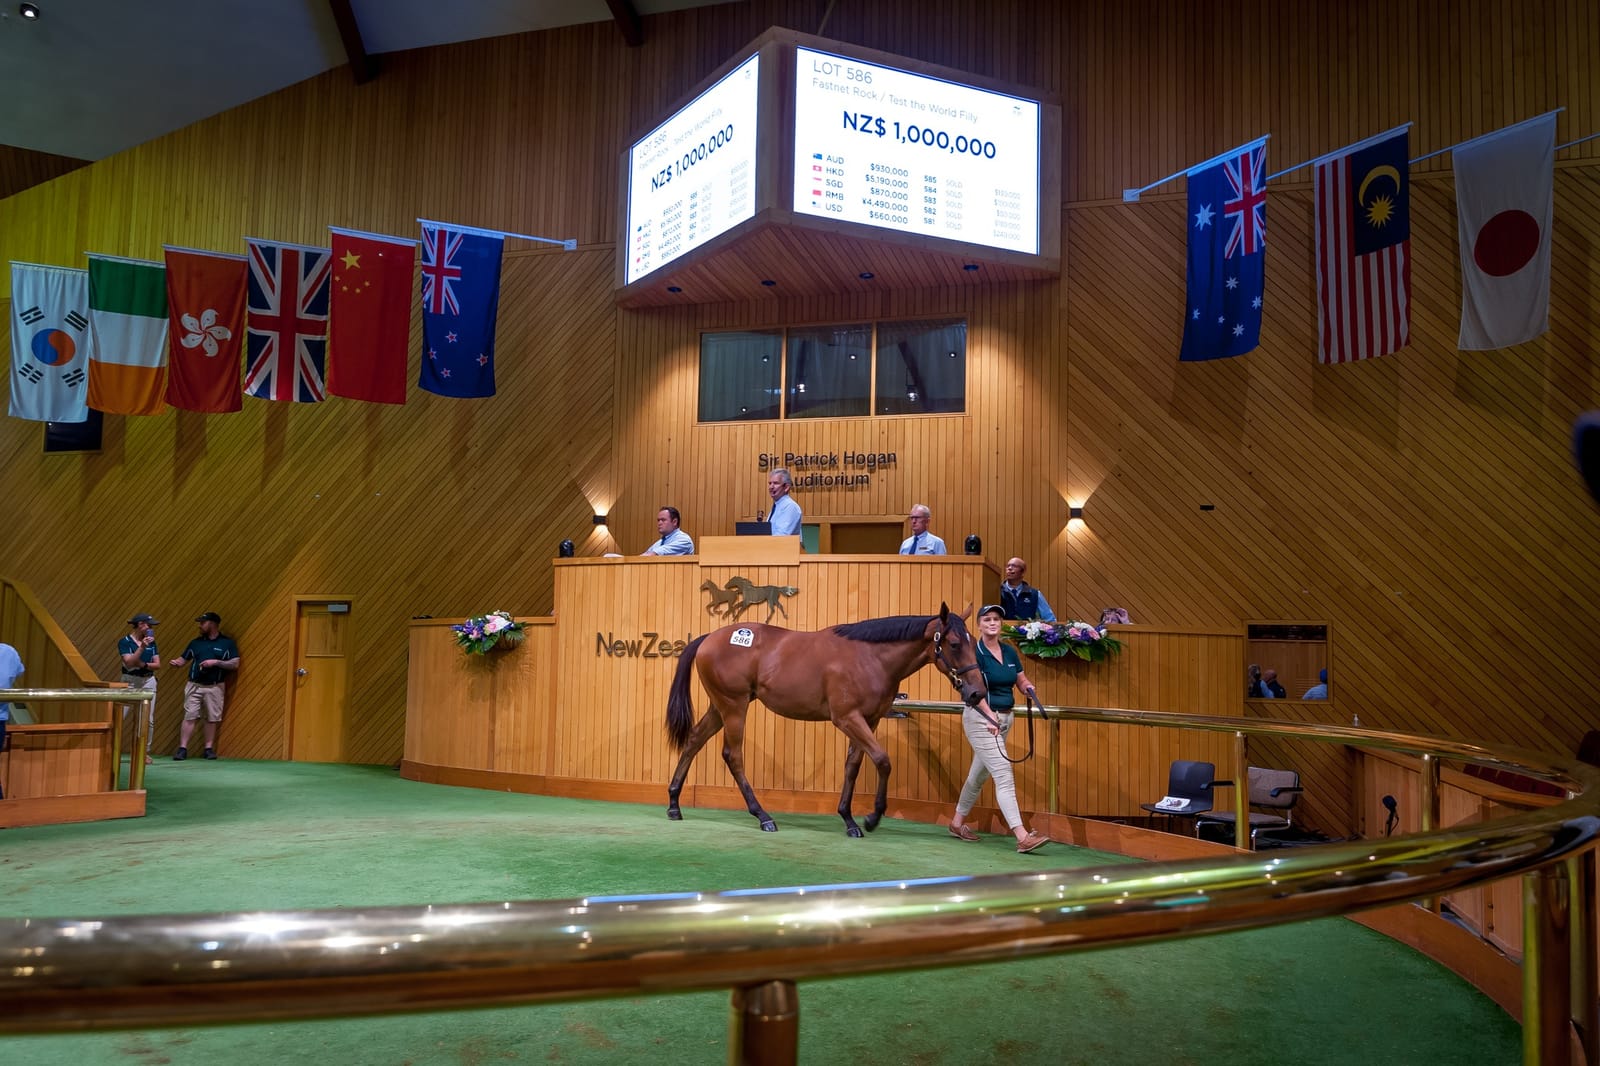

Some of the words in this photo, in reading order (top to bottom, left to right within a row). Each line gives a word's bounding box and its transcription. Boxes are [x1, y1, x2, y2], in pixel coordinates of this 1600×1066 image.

[813, 60, 842, 78] LOT
[846, 68, 872, 84] 586
[812, 78, 850, 94] Fastnet
[853, 86, 878, 100] Rock
[889, 94, 908, 108] Test
[911, 99, 926, 111] the
[929, 103, 957, 118] World
[959, 110, 978, 124] Filly
[843, 110, 886, 138] NZ$
[894, 122, 996, 159] 1,000,000
[651, 164, 672, 192] NZ$
[676, 124, 734, 177] 1,000,000
[826, 154, 844, 164] AUD
[826, 167, 844, 176] HKD
[826, 178, 843, 188] SGD
[826, 190, 844, 200] RMB
[826, 203, 843, 212] USD
[758, 453, 779, 468] Sir
[784, 452, 838, 467] Patrick
[843, 451, 897, 468] Hogan
[732, 636, 750, 645] 586
